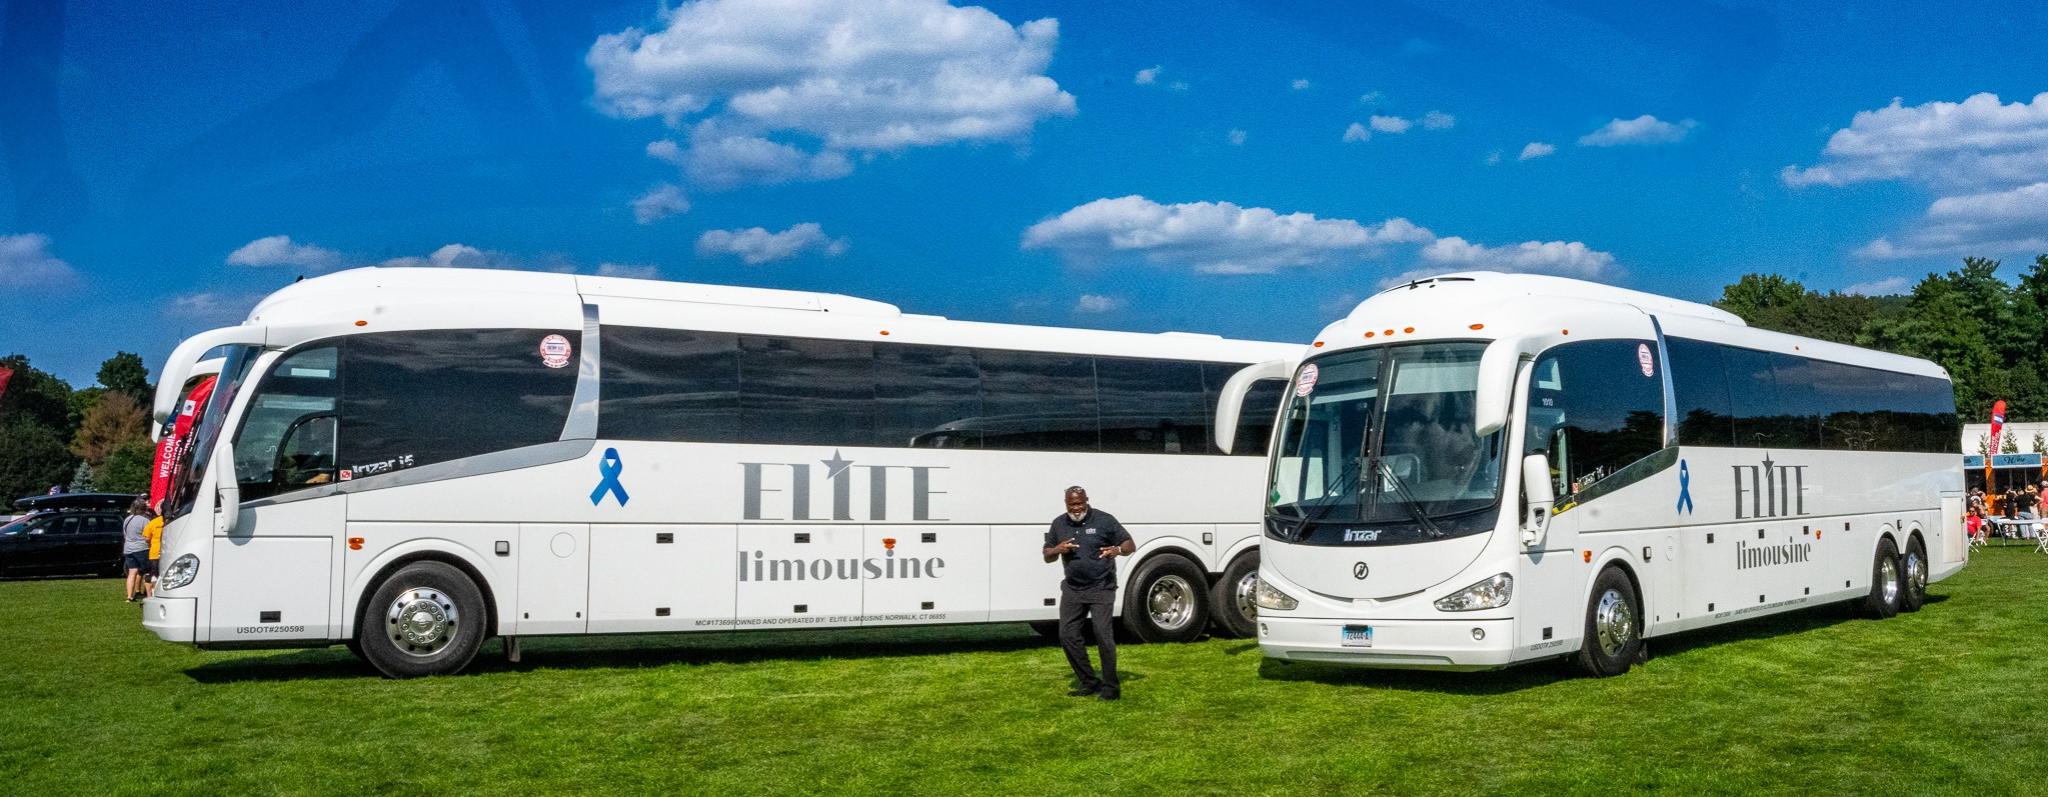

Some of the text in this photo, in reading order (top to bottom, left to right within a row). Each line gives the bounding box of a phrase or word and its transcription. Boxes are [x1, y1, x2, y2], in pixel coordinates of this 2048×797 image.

[160, 433, 176, 478] WELCOME
[738, 448, 950, 521] ELITE
[1731, 451, 1810, 519] ELITE
[739, 549, 945, 582] limousine
[1736, 536, 1811, 570] limousine
[236, 625, 305, 634] USDOT#250598
[736, 618, 761, 626] OWNED
[779, 617, 814, 625] OPERATED
